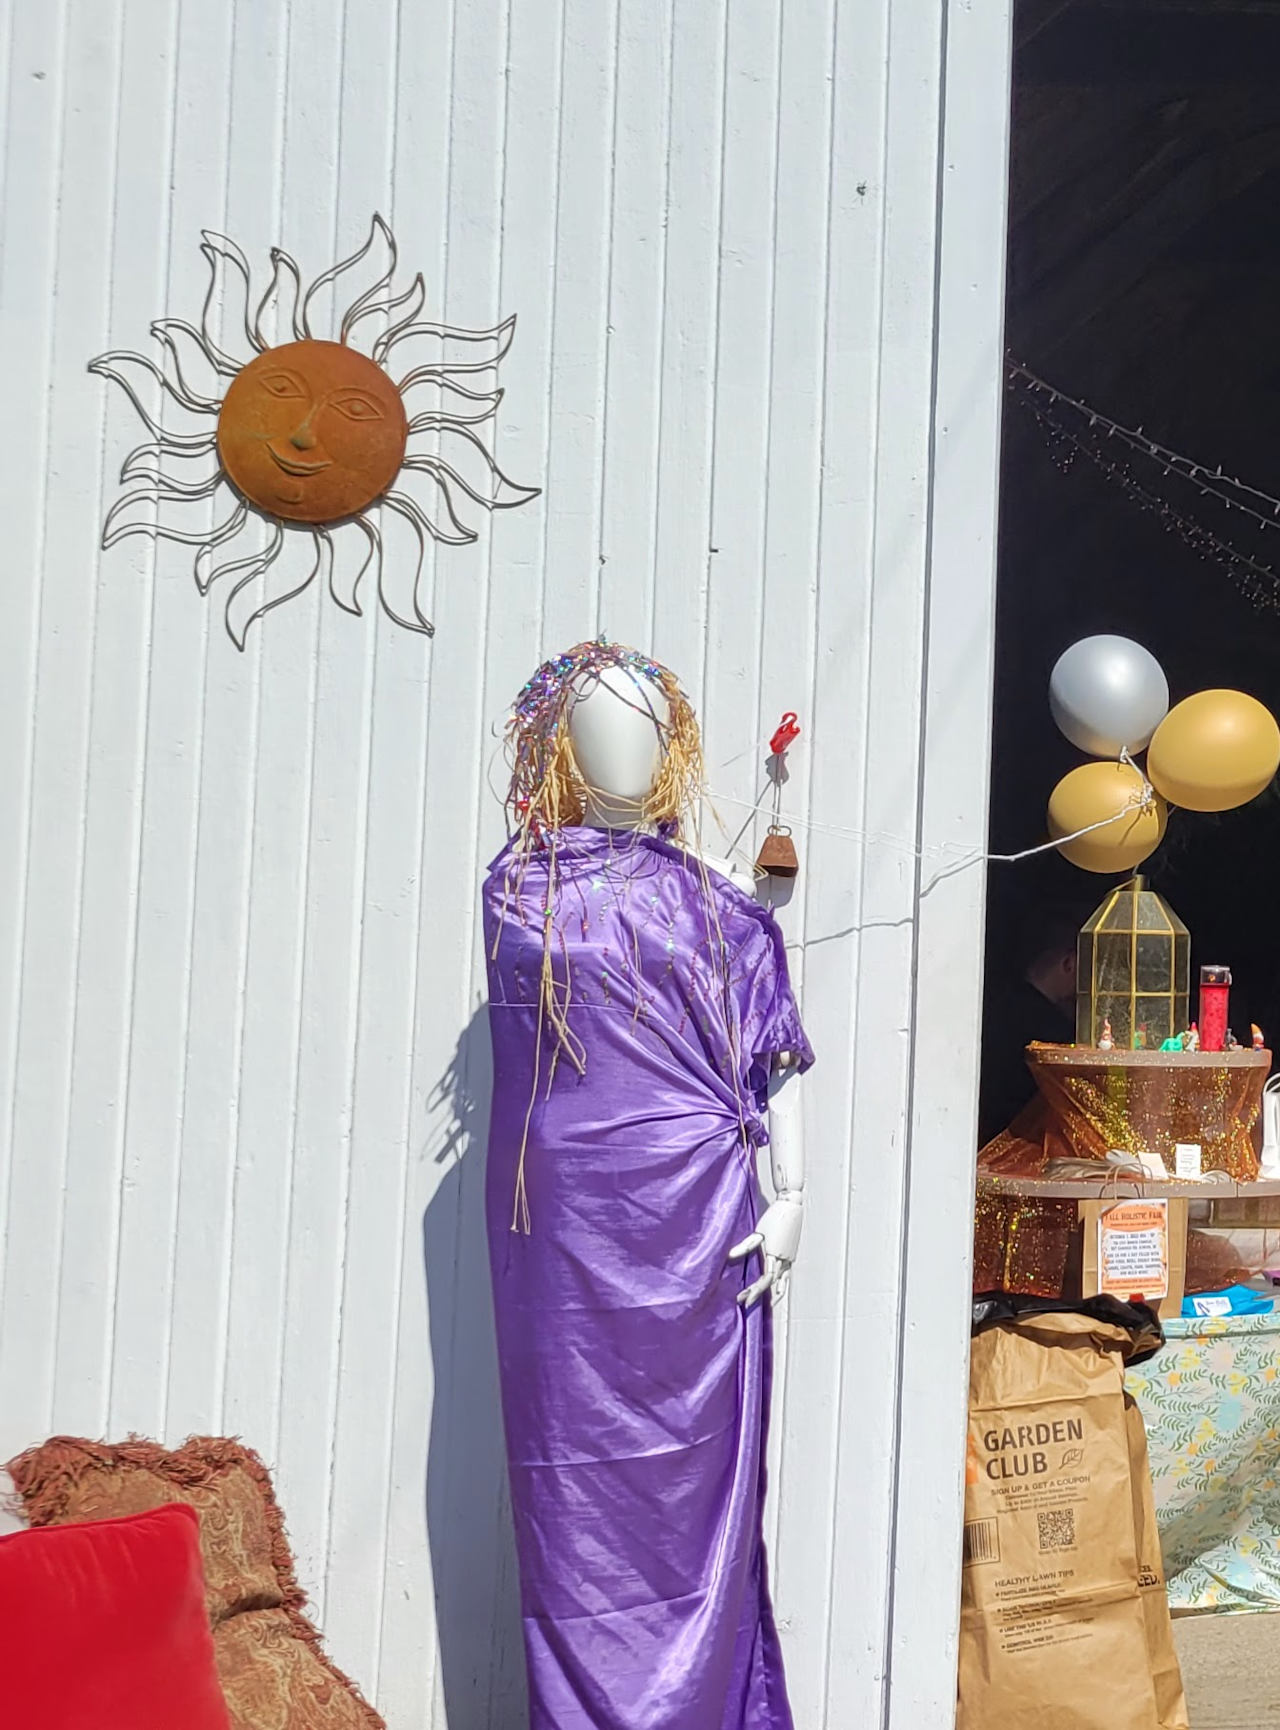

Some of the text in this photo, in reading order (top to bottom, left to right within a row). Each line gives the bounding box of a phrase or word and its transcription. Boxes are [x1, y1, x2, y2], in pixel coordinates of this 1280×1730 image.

[984, 1418, 1083, 1452] GARDEN
[986, 1450, 1048, 1481] CLUB
[991, 1486, 1009, 1496] SIGN
[1011, 1485, 1023, 1493] UP
[1032, 1481, 1047, 1490] GET
[1057, 1475, 1091, 1486] COUPON
[995, 1576, 1030, 1588] HEALTHY
[1032, 1571, 1057, 1582] LAWN
[1058, 1569, 1074, 1577] TIPS
